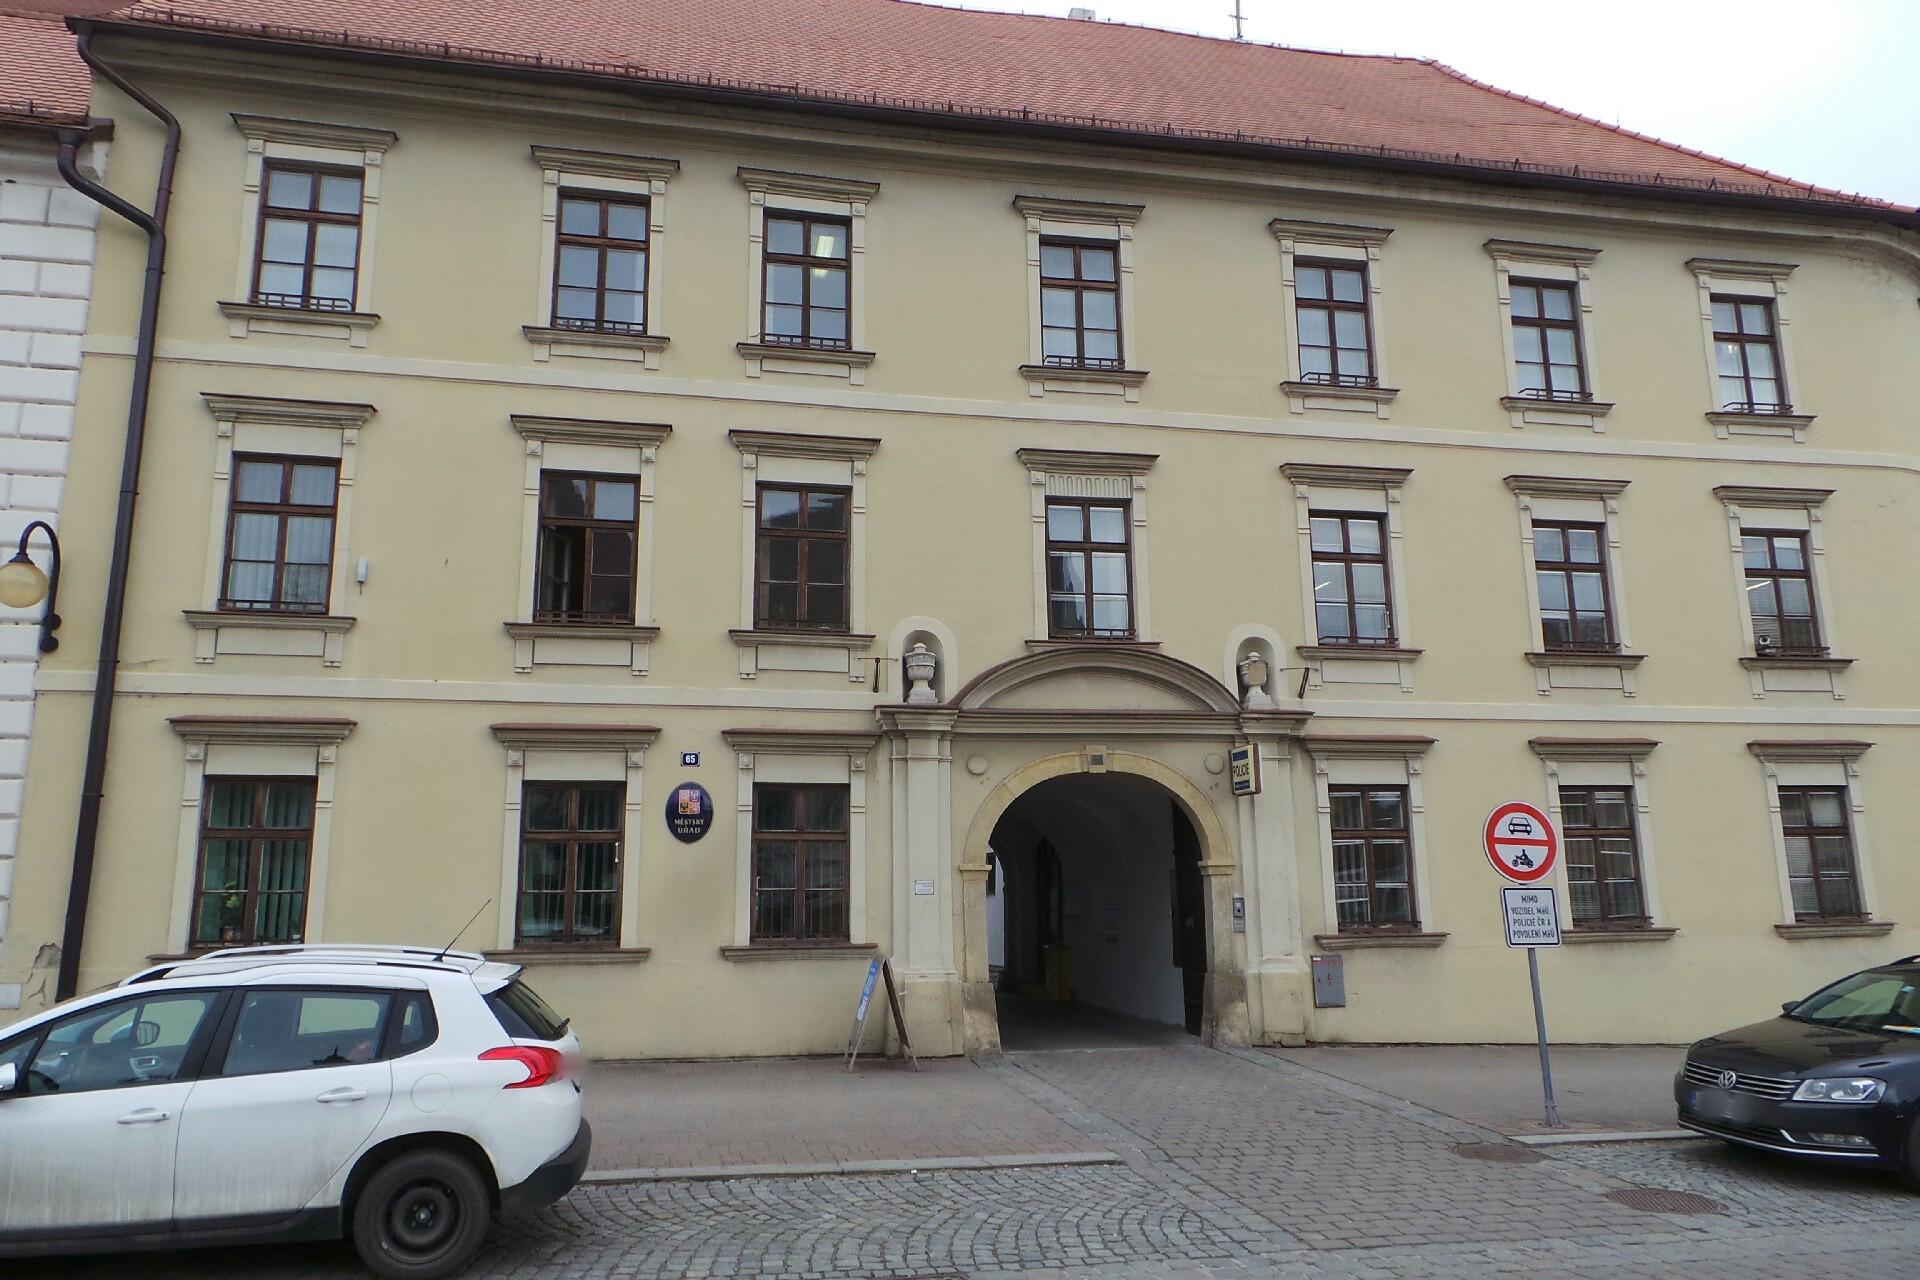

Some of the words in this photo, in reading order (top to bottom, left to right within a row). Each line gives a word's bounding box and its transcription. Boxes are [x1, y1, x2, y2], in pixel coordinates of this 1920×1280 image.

[685, 755, 695, 763] 65
[674, 817, 704, 825] MĚSTSKÝ
[677, 826, 701, 834] ÚŘAD
[1521, 895, 1538, 903] MIMO
[1511, 906, 1535, 915] VOZIDEL
[1513, 918, 1536, 927] POLICIE
[1538, 916, 1545, 926] ČR
[1547, 918, 1551, 926] A
[1512, 929, 1541, 939] POVOLENÍ
